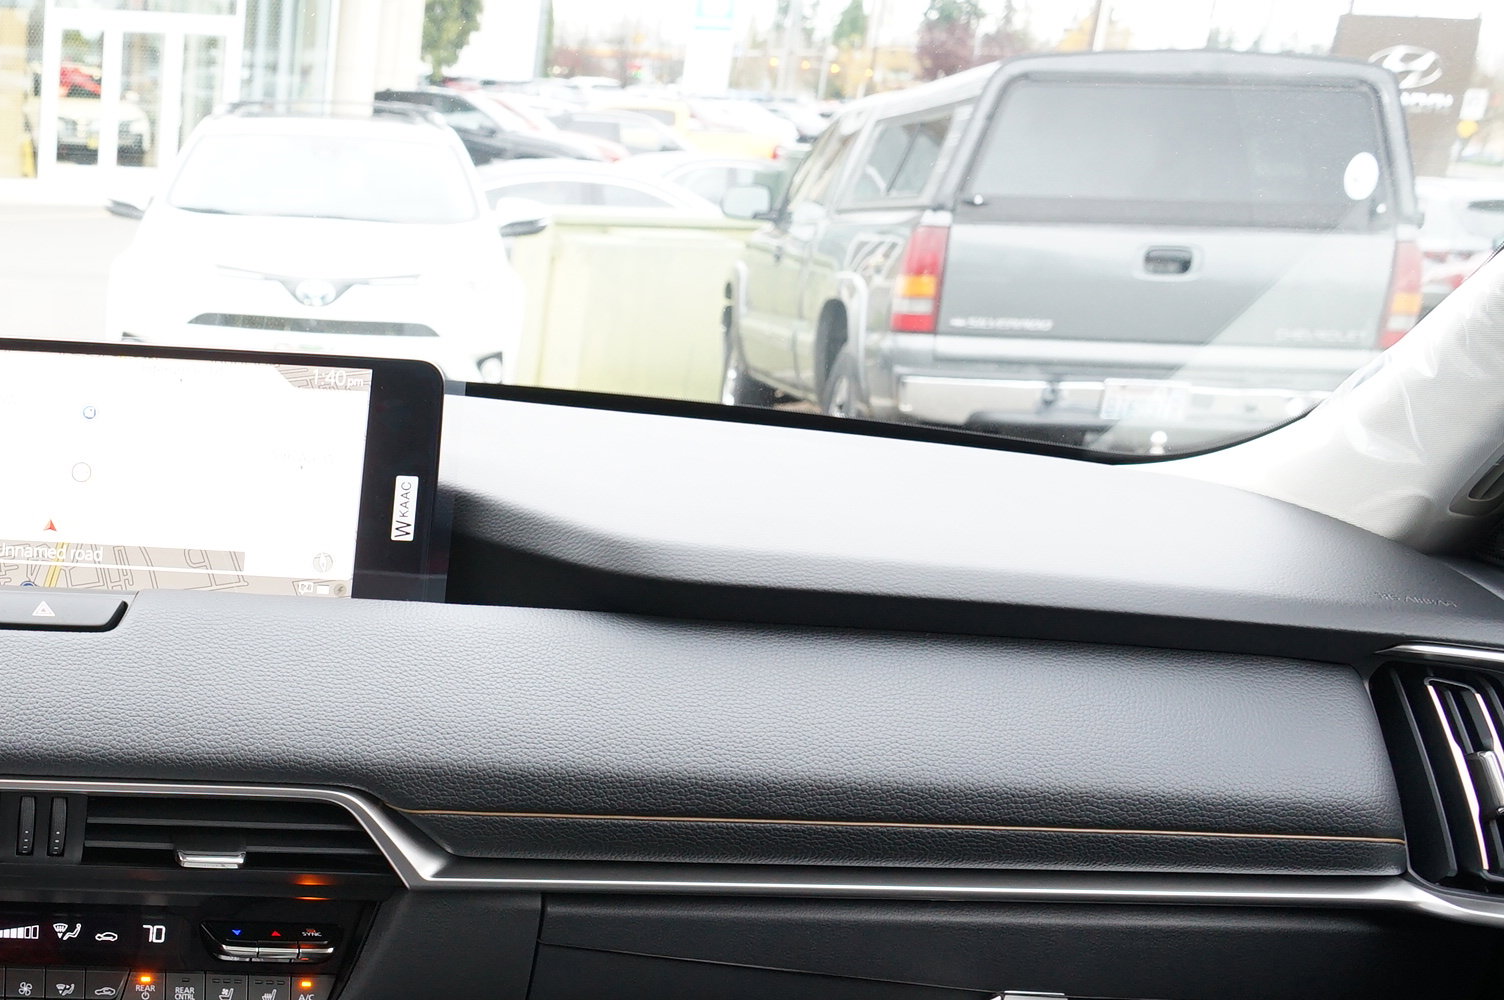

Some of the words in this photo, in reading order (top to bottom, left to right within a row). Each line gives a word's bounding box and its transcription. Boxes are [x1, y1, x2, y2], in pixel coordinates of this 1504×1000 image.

[70, 546, 103, 562] road
[142, 925, 166, 943] 70
[135, 984, 156, 992] REAR
[174, 986, 195, 994] REAR
